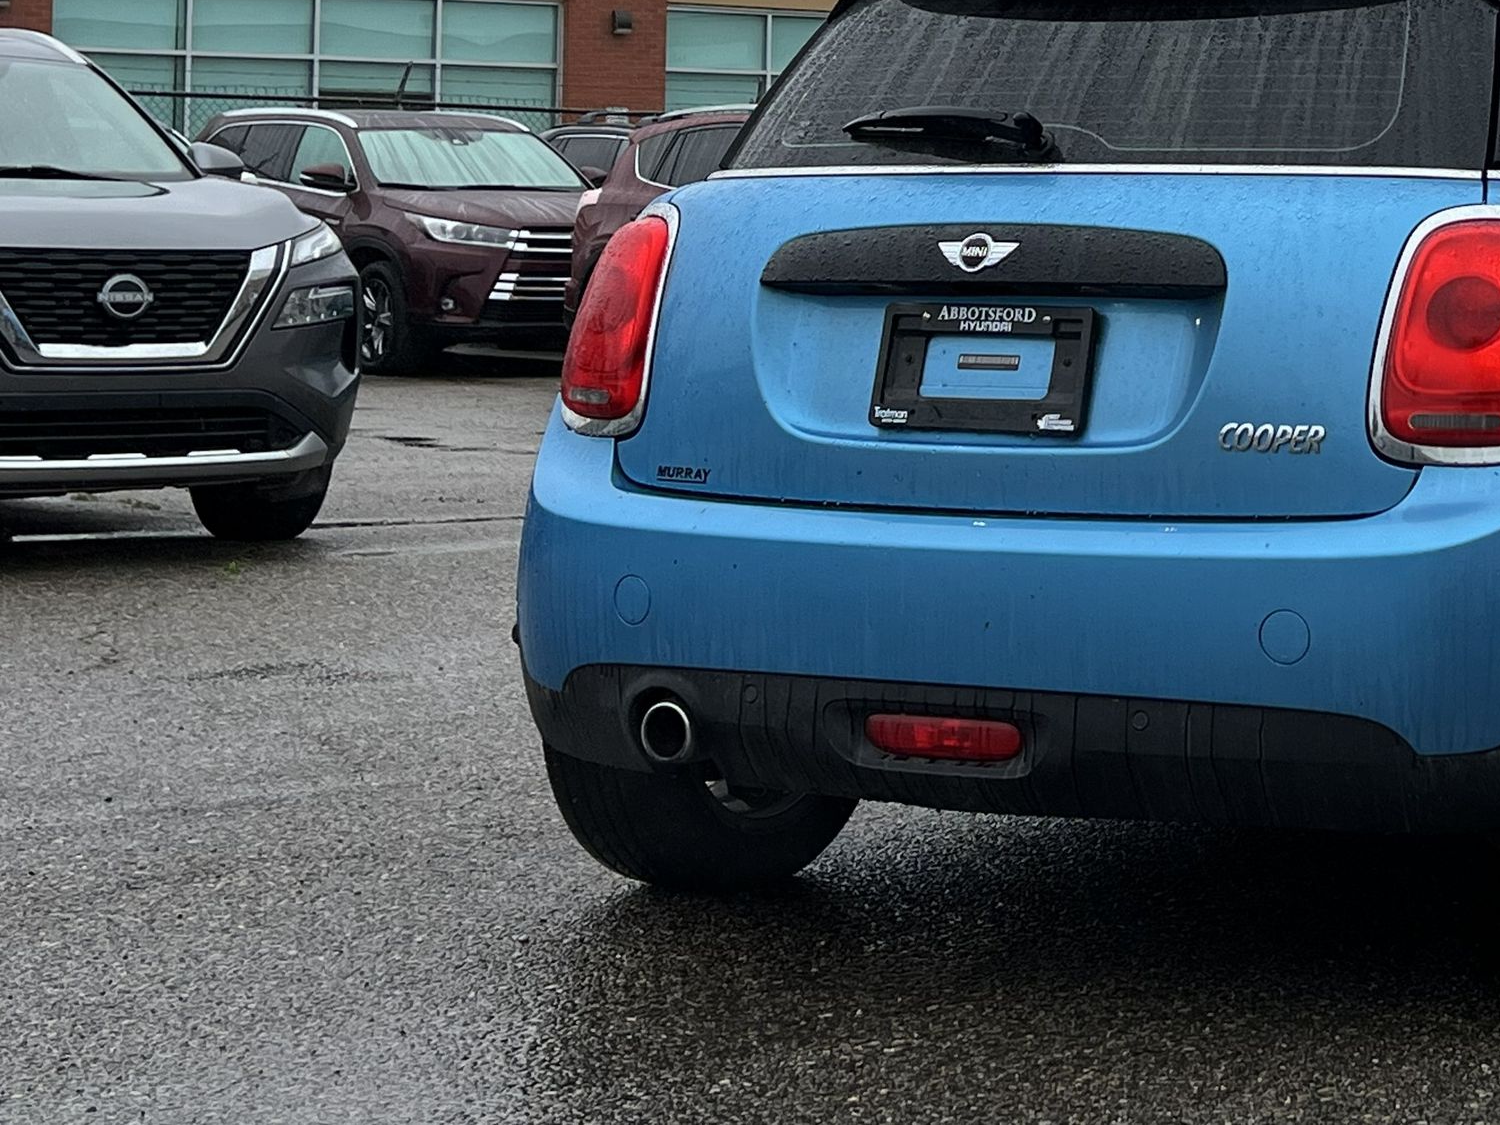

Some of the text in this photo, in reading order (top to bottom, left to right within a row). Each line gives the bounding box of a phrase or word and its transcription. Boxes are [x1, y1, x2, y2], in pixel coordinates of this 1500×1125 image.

[961, 246, 988, 257] MINI
[97, 292, 153, 303] NISSAN
[938, 305, 1037, 323] ABBOTSFORD
[960, 321, 1013, 333] HYUNDAI
[1219, 422, 1326, 454] COOPER
[657, 465, 711, 484] MURRAY
